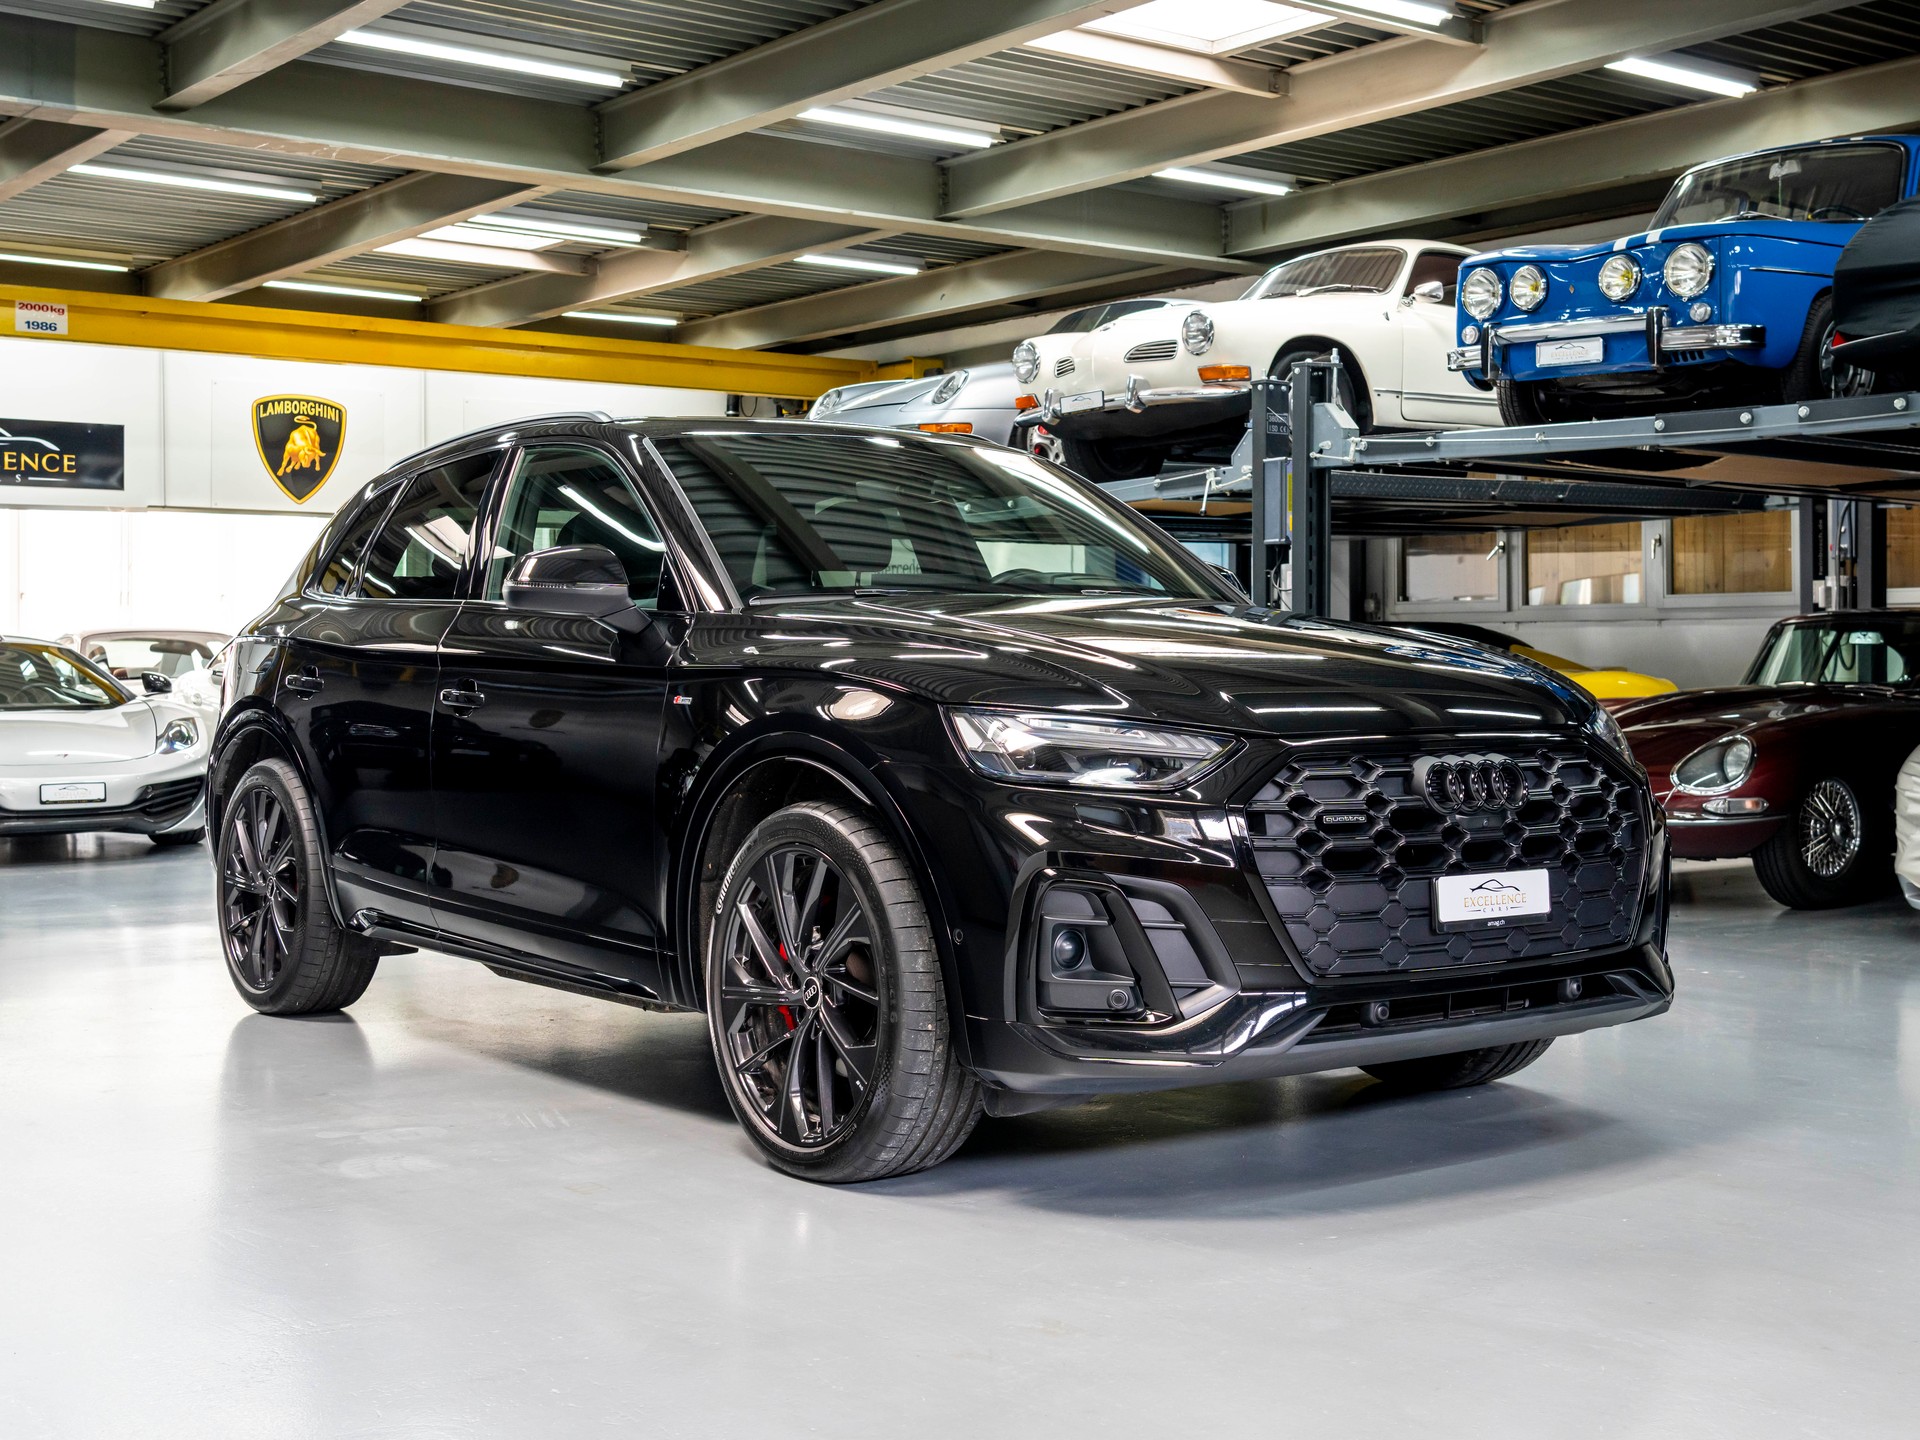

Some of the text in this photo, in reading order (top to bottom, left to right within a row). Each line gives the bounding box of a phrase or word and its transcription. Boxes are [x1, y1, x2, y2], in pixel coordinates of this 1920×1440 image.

[25, 320, 57, 331] 1986
[260, 400, 339, 423] LAMBORGHINI
[3, 451, 77, 473] ENCE
[1325, 815, 1365, 823] quattro
[1464, 893, 1527, 908] EXCELLENCE
